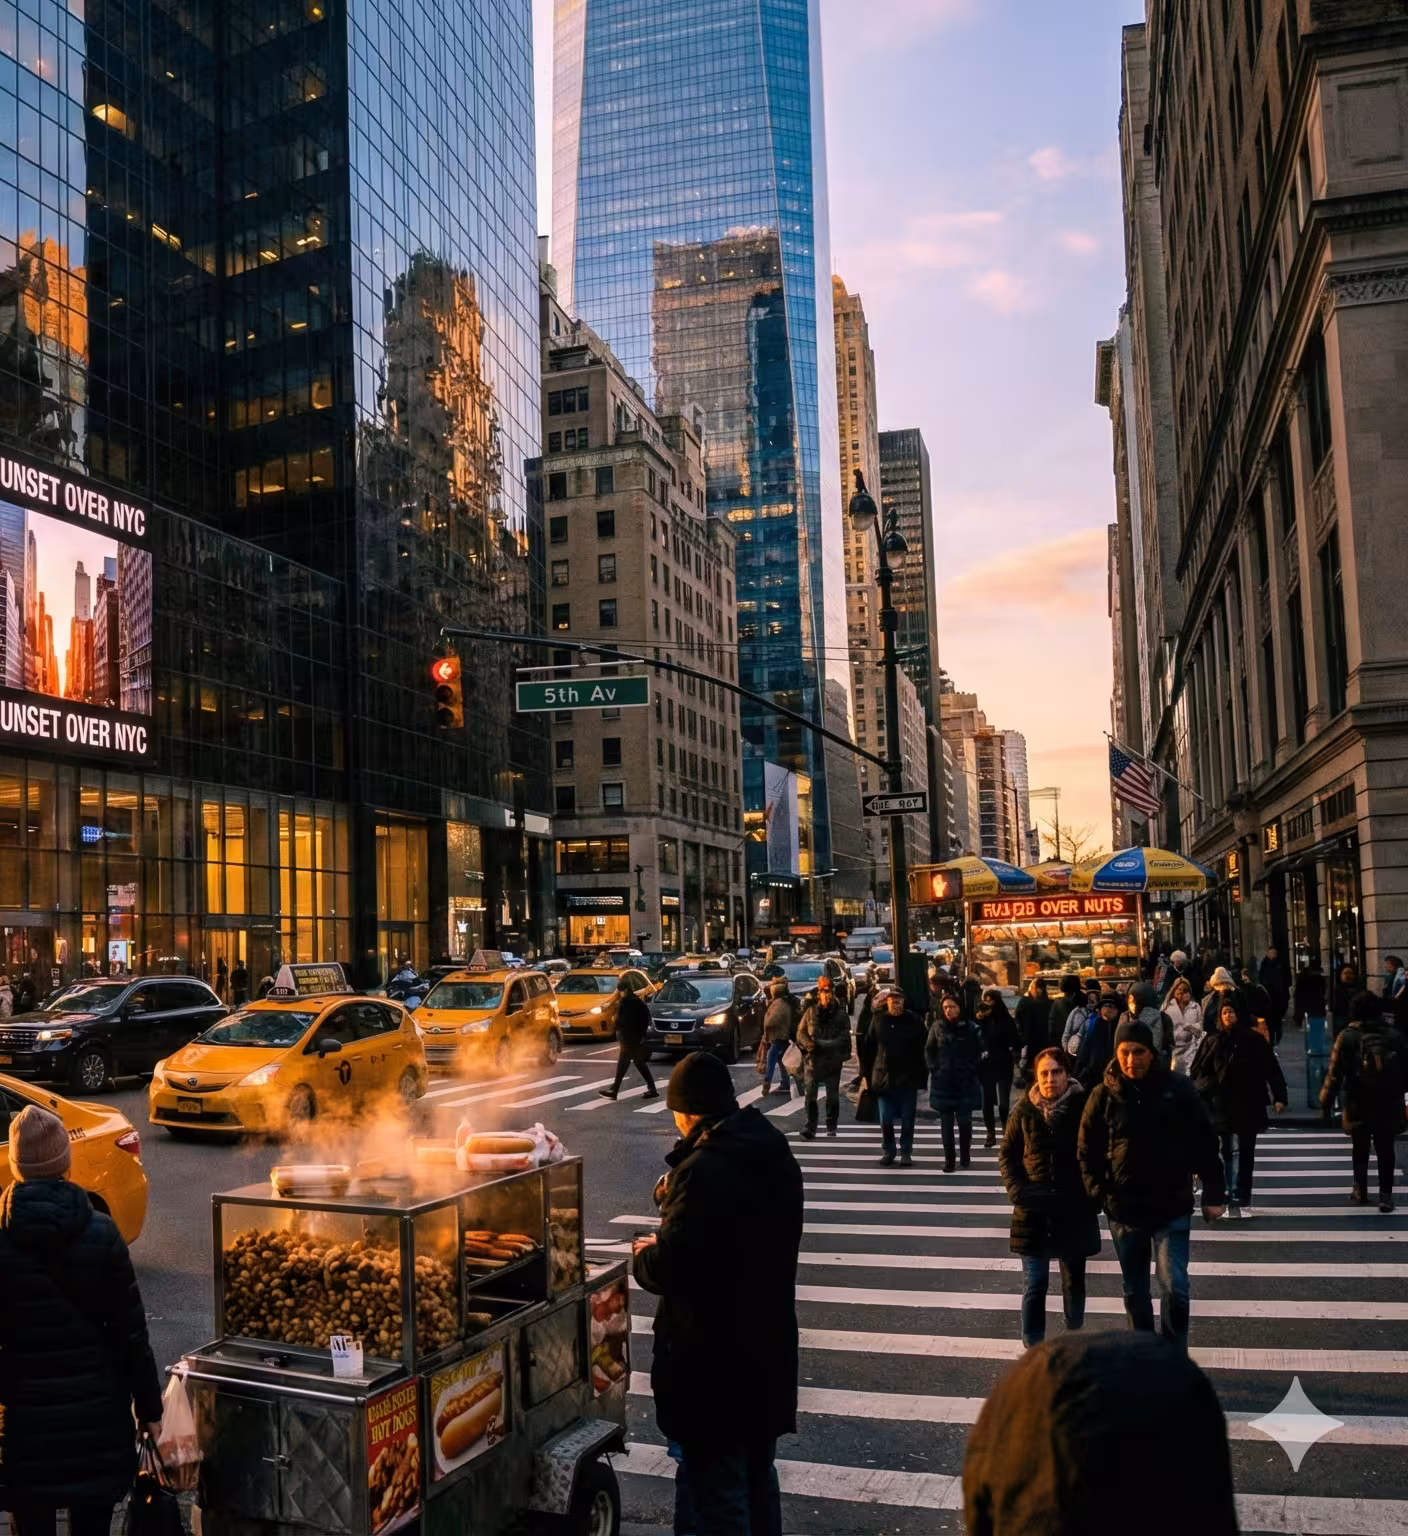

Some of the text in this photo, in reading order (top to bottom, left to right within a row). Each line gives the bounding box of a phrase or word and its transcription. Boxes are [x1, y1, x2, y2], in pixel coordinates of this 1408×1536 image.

[64, 483, 110, 524] OVER
[113, 500, 146, 537] NYC
[544, 685, 617, 703] 5th Av
[66, 713, 111, 748] OVER
[115, 724, 147, 755] NYC
[1040, 899, 1079, 915] OVER
[1084, 897, 1123, 913] NUTS
